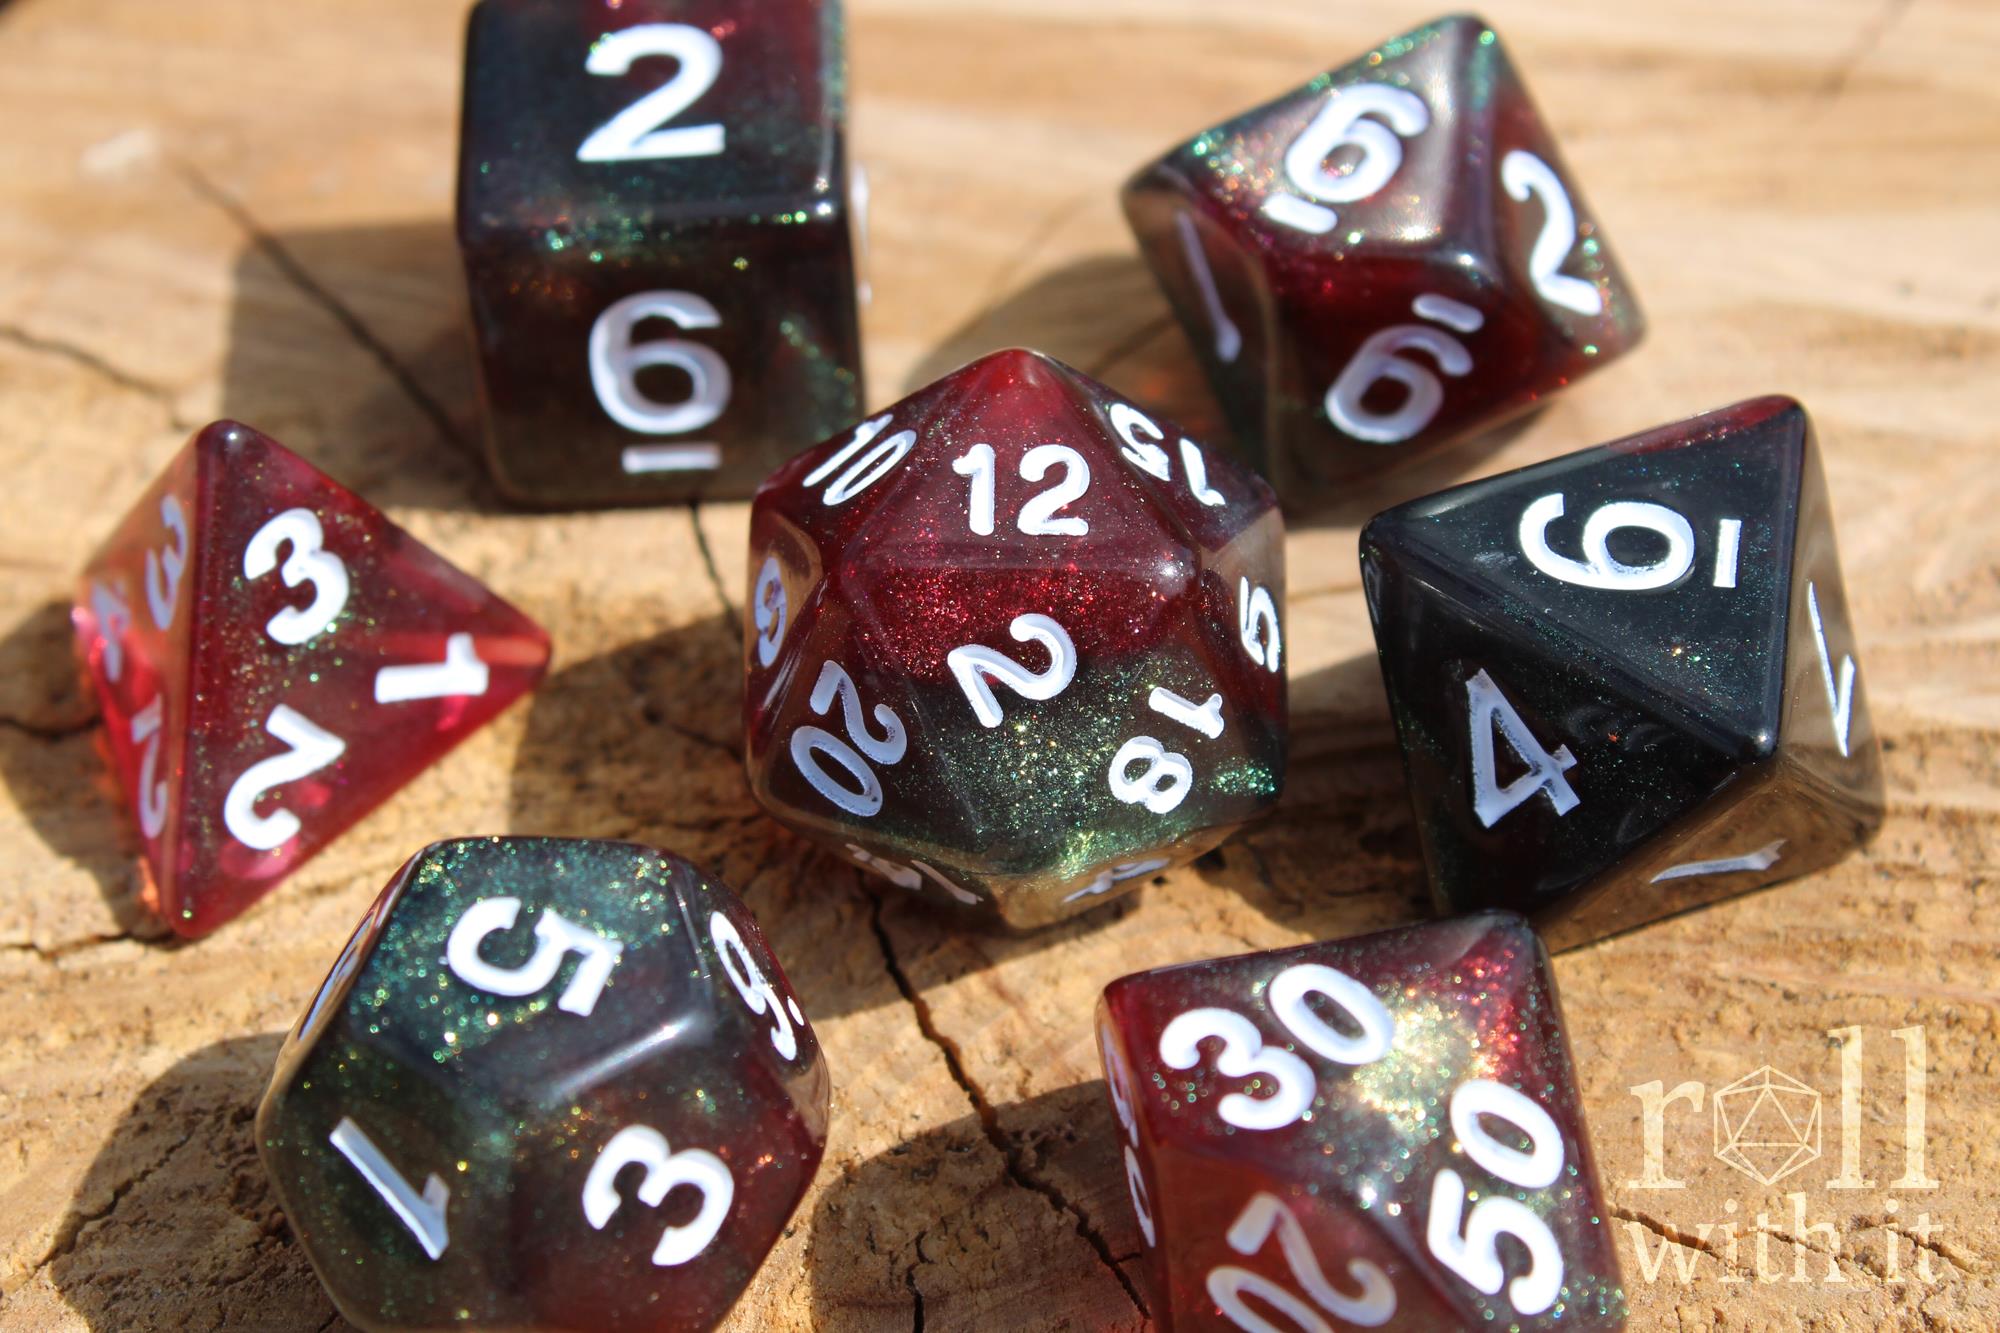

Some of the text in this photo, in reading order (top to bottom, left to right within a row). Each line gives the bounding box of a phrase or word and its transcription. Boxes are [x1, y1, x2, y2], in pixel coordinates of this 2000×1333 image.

[576, 23, 725, 161] 2
[1263, 82, 1430, 234] 6
[1501, 149, 1602, 316] 2
[588, 289, 732, 473] 6
[803, 413, 917, 505] 10
[952, 443, 1090, 536] 12
[1109, 403, 1227, 506] 15
[144, 494, 188, 631] 3
[243, 507, 350, 646] 3
[1518, 493, 1742, 590] 6
[374, 632, 490, 703] 1
[790, 659, 907, 816] 20
[947, 613, 1077, 728] 2
[131, 693, 168, 840] 2
[224, 703, 346, 851] 2
[1108, 686, 1225, 813] 18
[1465, 667, 1581, 829] 4
[446, 896, 623, 1016] 5
[1159, 963, 1395, 1131] 30
[328, 1115, 450, 1260] 1
[582, 1124, 734, 1266] 3
[1427, 1078, 1564, 1315] 50
[1206, 1190, 1397, 1333] 20
